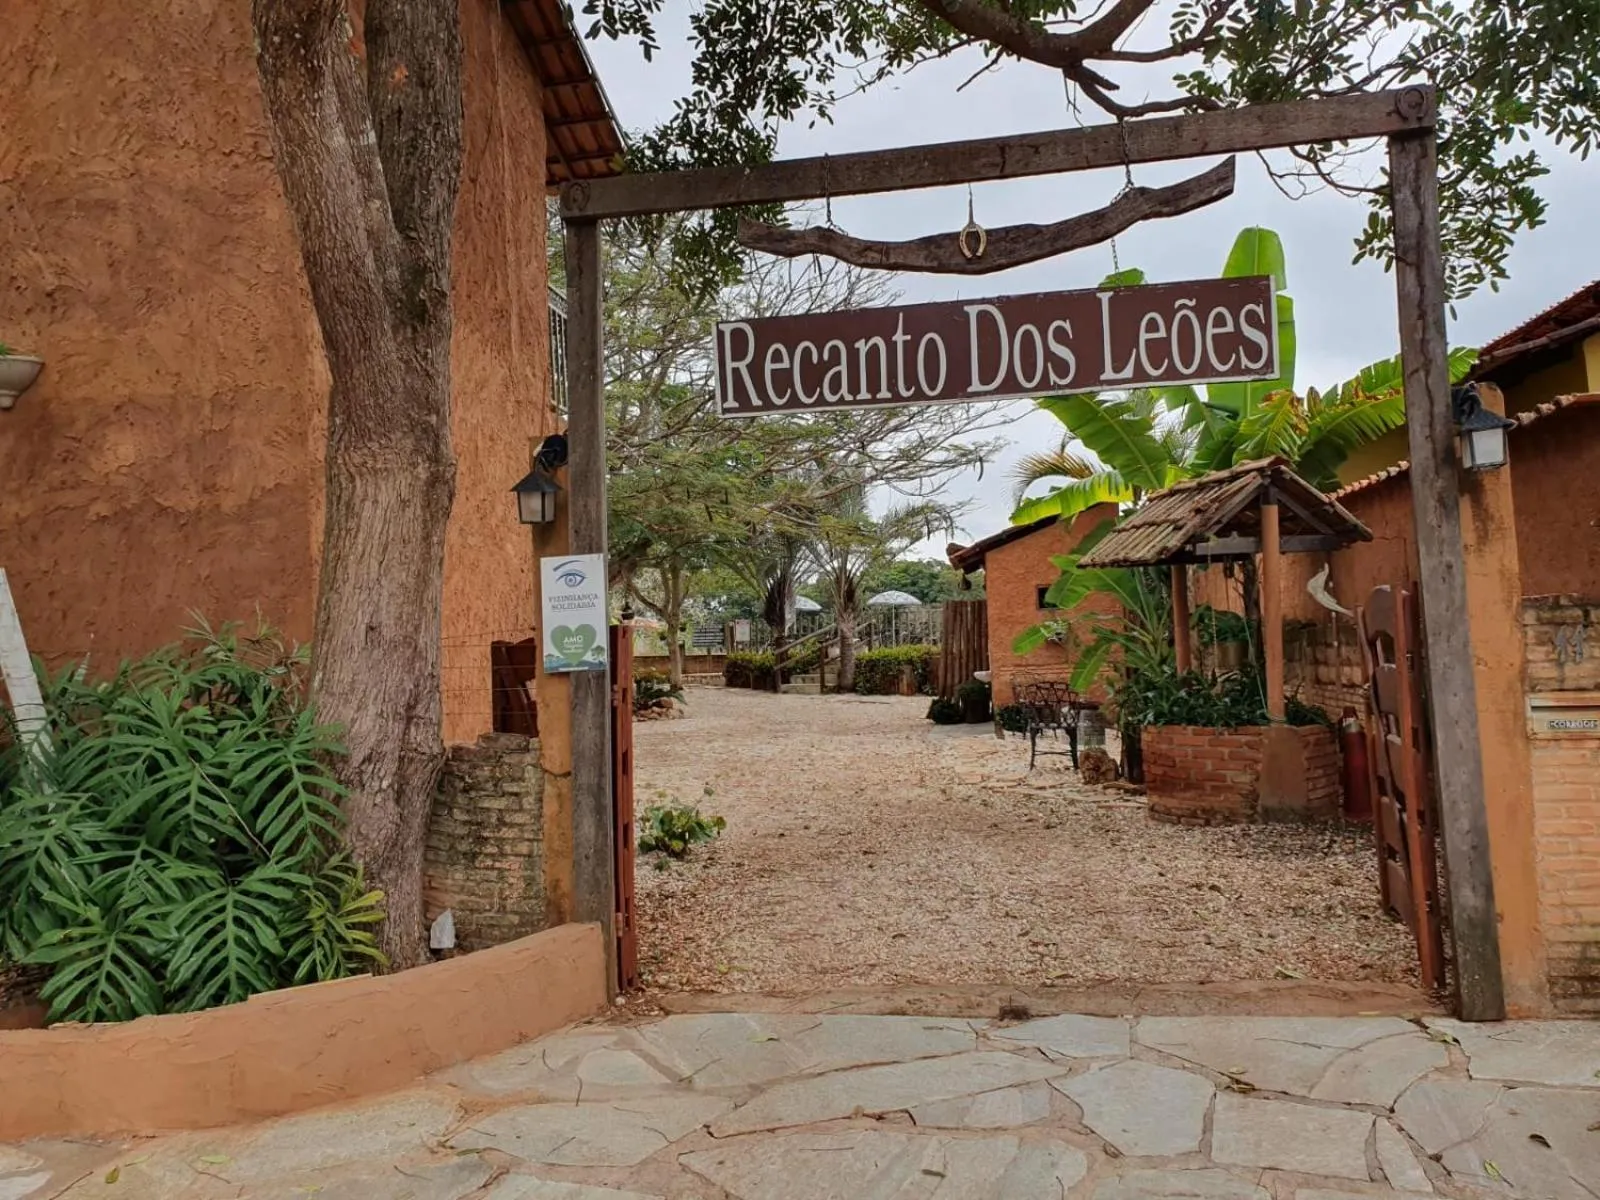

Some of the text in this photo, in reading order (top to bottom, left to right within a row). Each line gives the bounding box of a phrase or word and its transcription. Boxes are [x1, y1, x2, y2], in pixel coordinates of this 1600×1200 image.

[719, 290, 1270, 409] Recanto Dos Leões
